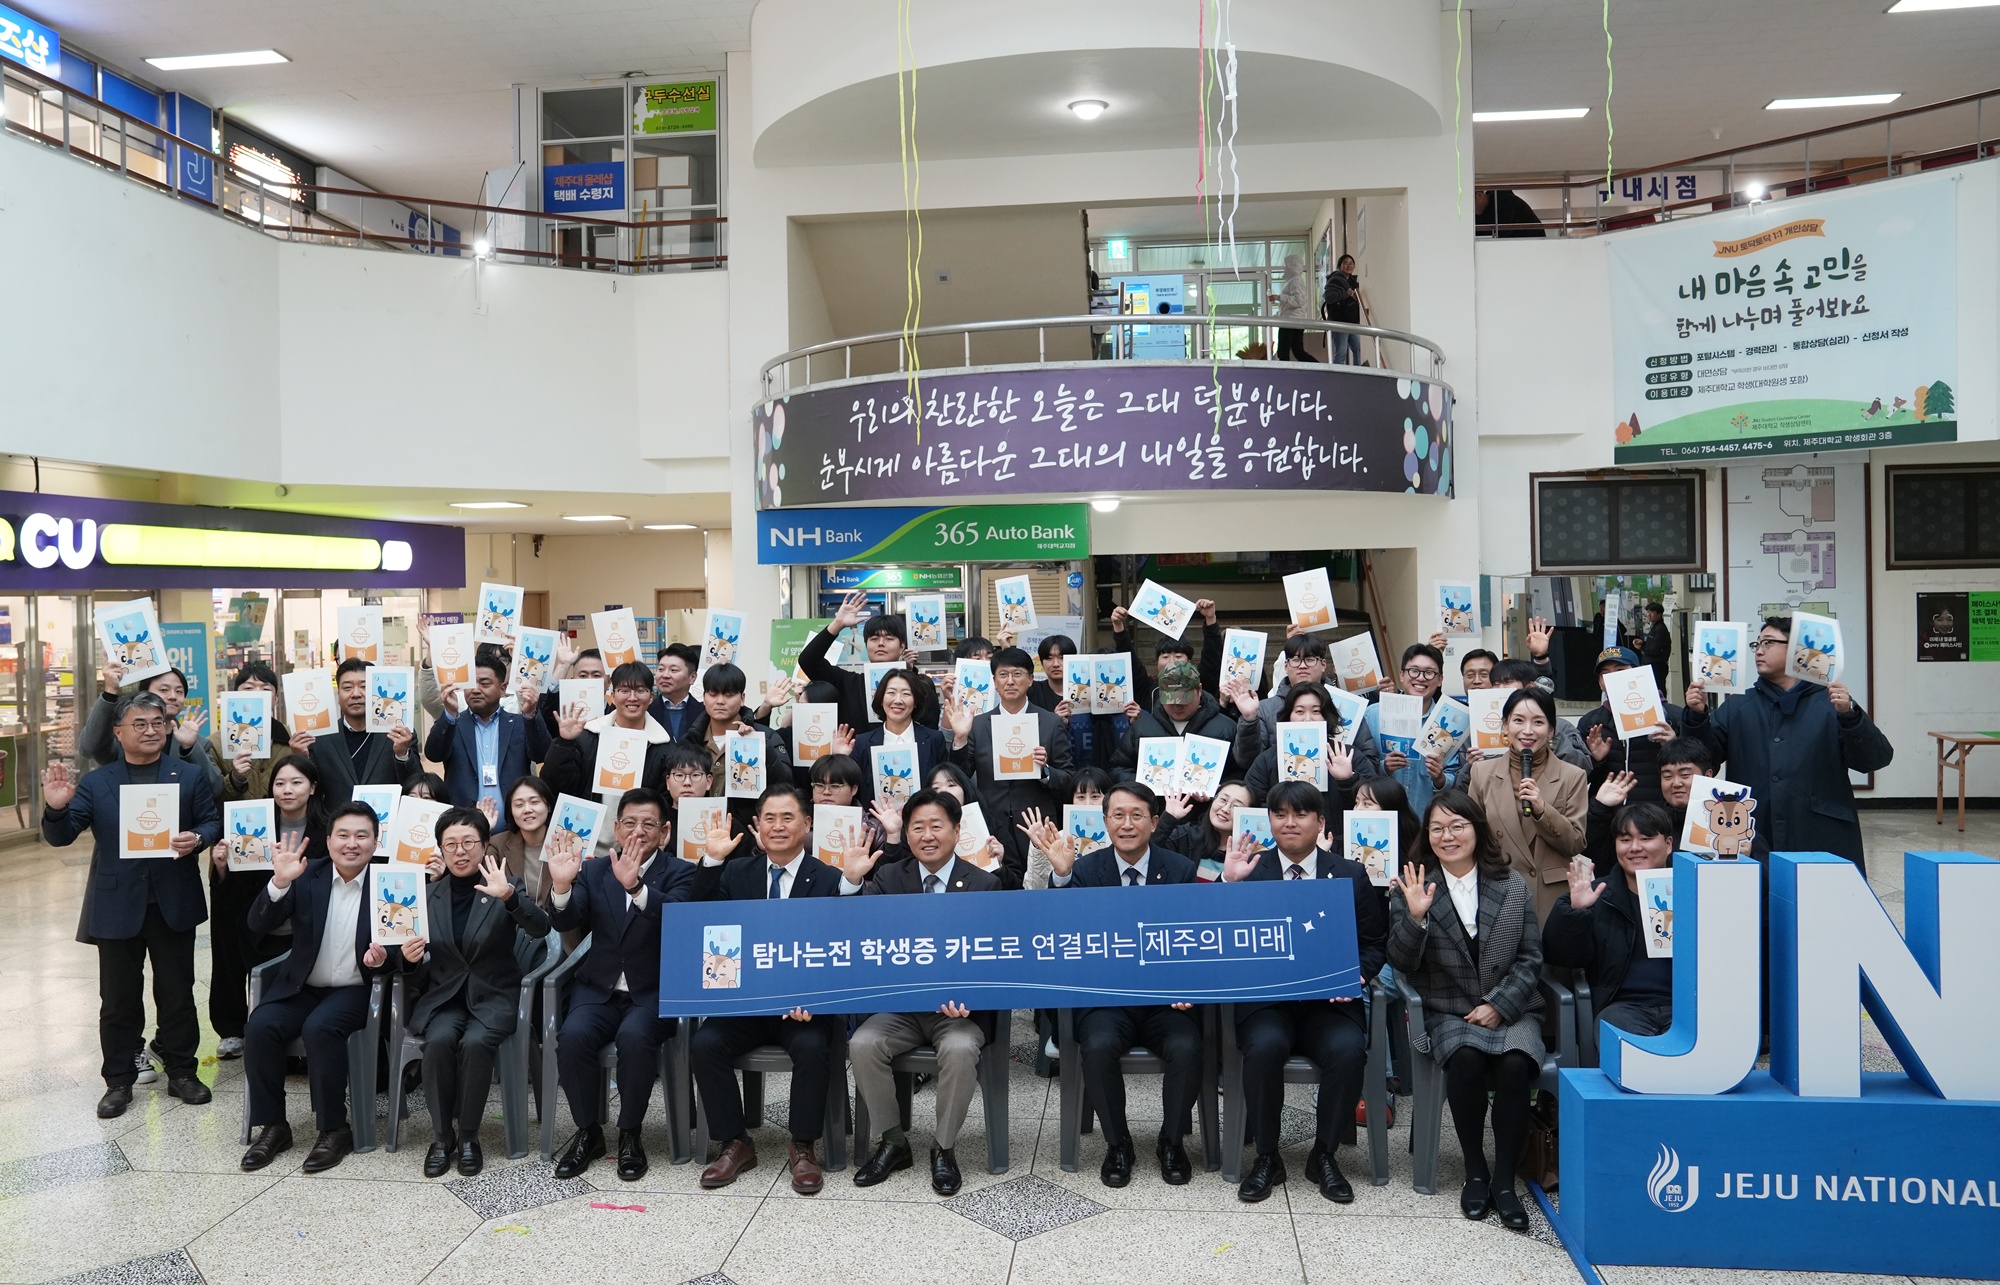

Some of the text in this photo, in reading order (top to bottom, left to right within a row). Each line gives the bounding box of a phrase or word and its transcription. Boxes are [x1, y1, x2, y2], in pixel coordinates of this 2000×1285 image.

[554, 172, 614, 188] 제주대 올레샵
[554, 187, 614, 202] 택배 수령지
[1718, 245, 1738, 255] JNU
[1740, 234, 1772, 251] 토닥토닥
[1784, 223, 1818, 236] 개인상담
[1679, 246, 1867, 300] 내 마음 속 고민을
[1676, 294, 1870, 338] 함께 나누며 풀어봐요
[1696, 349, 1735, 362] 포털시스템
[1862, 330, 1889, 342] 신청서
[1891, 327, 1909, 338] 작성
[1697, 368, 1728, 378] 대면상담
[1698, 382, 1736, 394] 제주대학교
[849, 383, 1333, 442] 우리의 찬란한 오늘은 그대 덕분입니다.
[1660, 448, 1678, 456] TEL.
[1681, 446, 1700, 455] 064)
[1803, 436, 1842, 446] 제주대학교
[1844, 432, 1876, 442] 학생회관
[1878, 431, 1892, 440] 3층
[820, 432, 1368, 495] 눈부시게 아름다운 그대의 내일을 응원합니다.
[20, 512, 97, 570] CU
[770, 521, 1076, 547] NH Bank 365 Auto Bank
[886, 572, 902, 582] 365
[752, 924, 1286, 969] 탐나는전 학생증 카드로 연결되는 제주의 미래
[1716, 1172, 2000, 1208] JEJU NATIONAL
